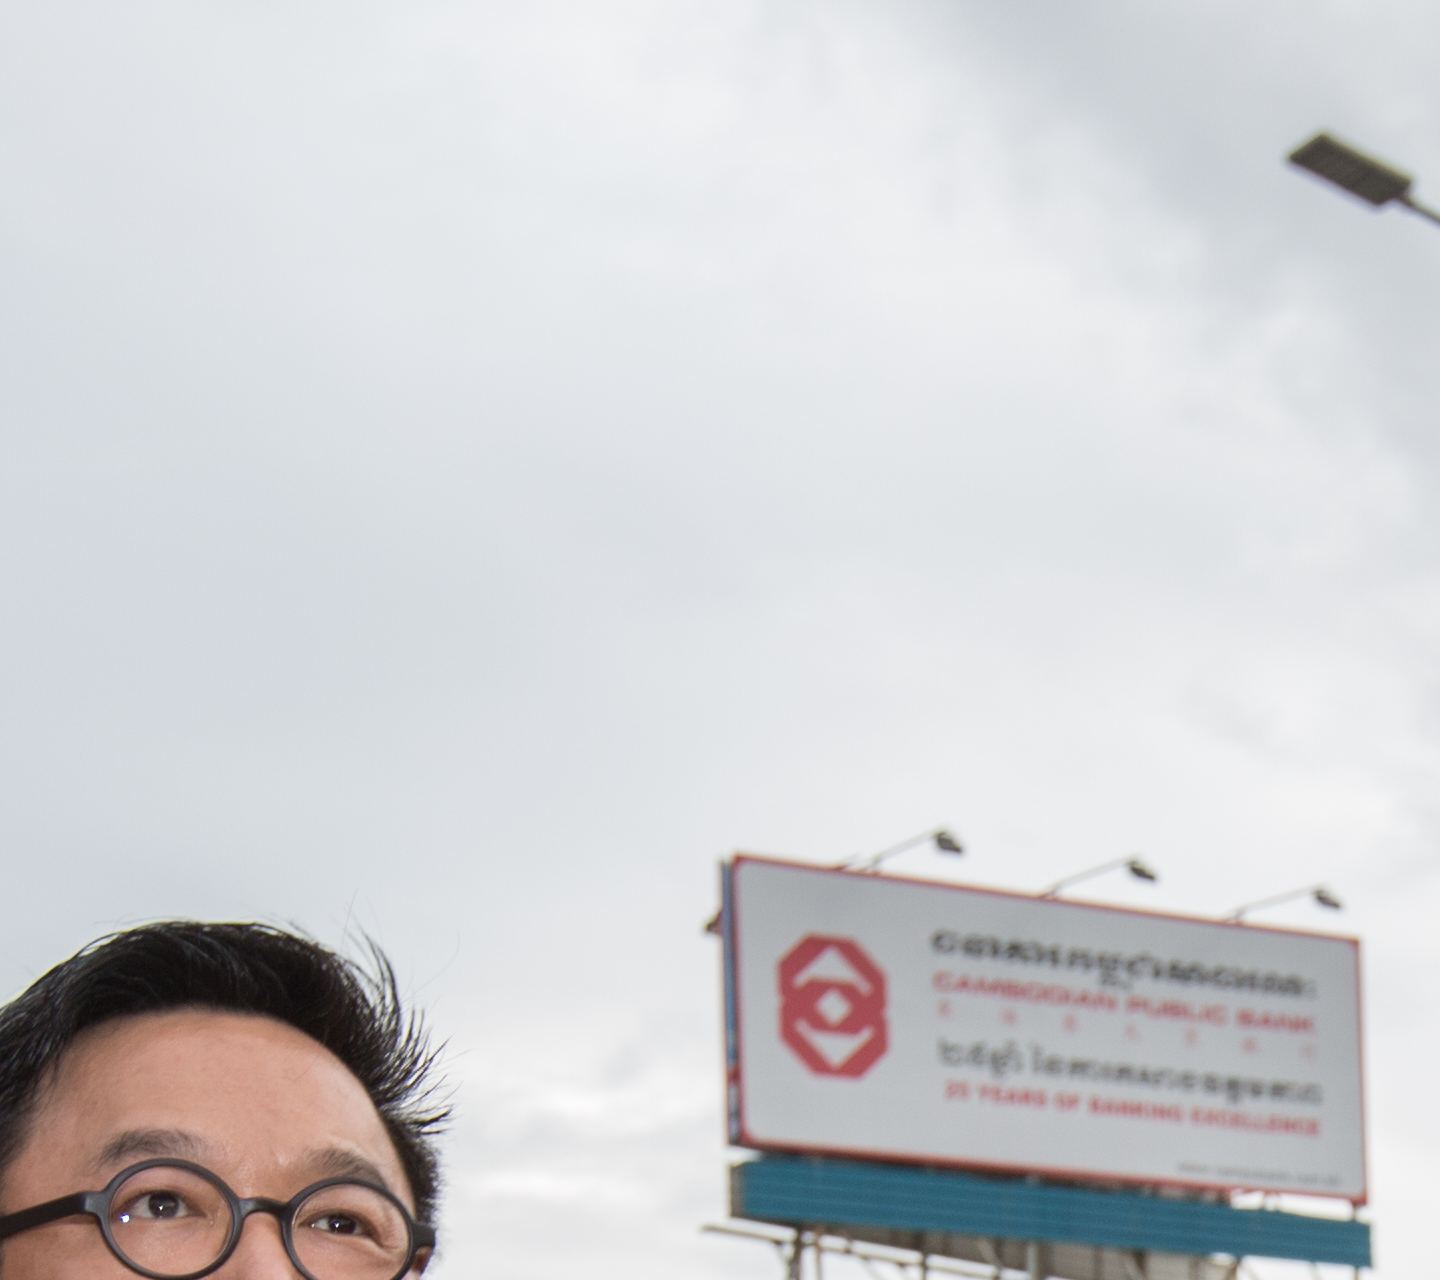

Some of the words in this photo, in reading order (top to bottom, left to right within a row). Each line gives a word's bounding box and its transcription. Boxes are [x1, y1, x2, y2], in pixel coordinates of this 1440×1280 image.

[931, 969, 1118, 1012] CAMBODIAN
[1124, 995, 1230, 1027] PUBLIC
[1235, 1007, 1315, 1034] BANK
[978, 1081, 1048, 1109] YEARS
[1054, 1090, 1081, 1113] OF
[1087, 1094, 1185, 1125] BANKING
[1190, 1105, 1322, 1138] EXCELLENCE
